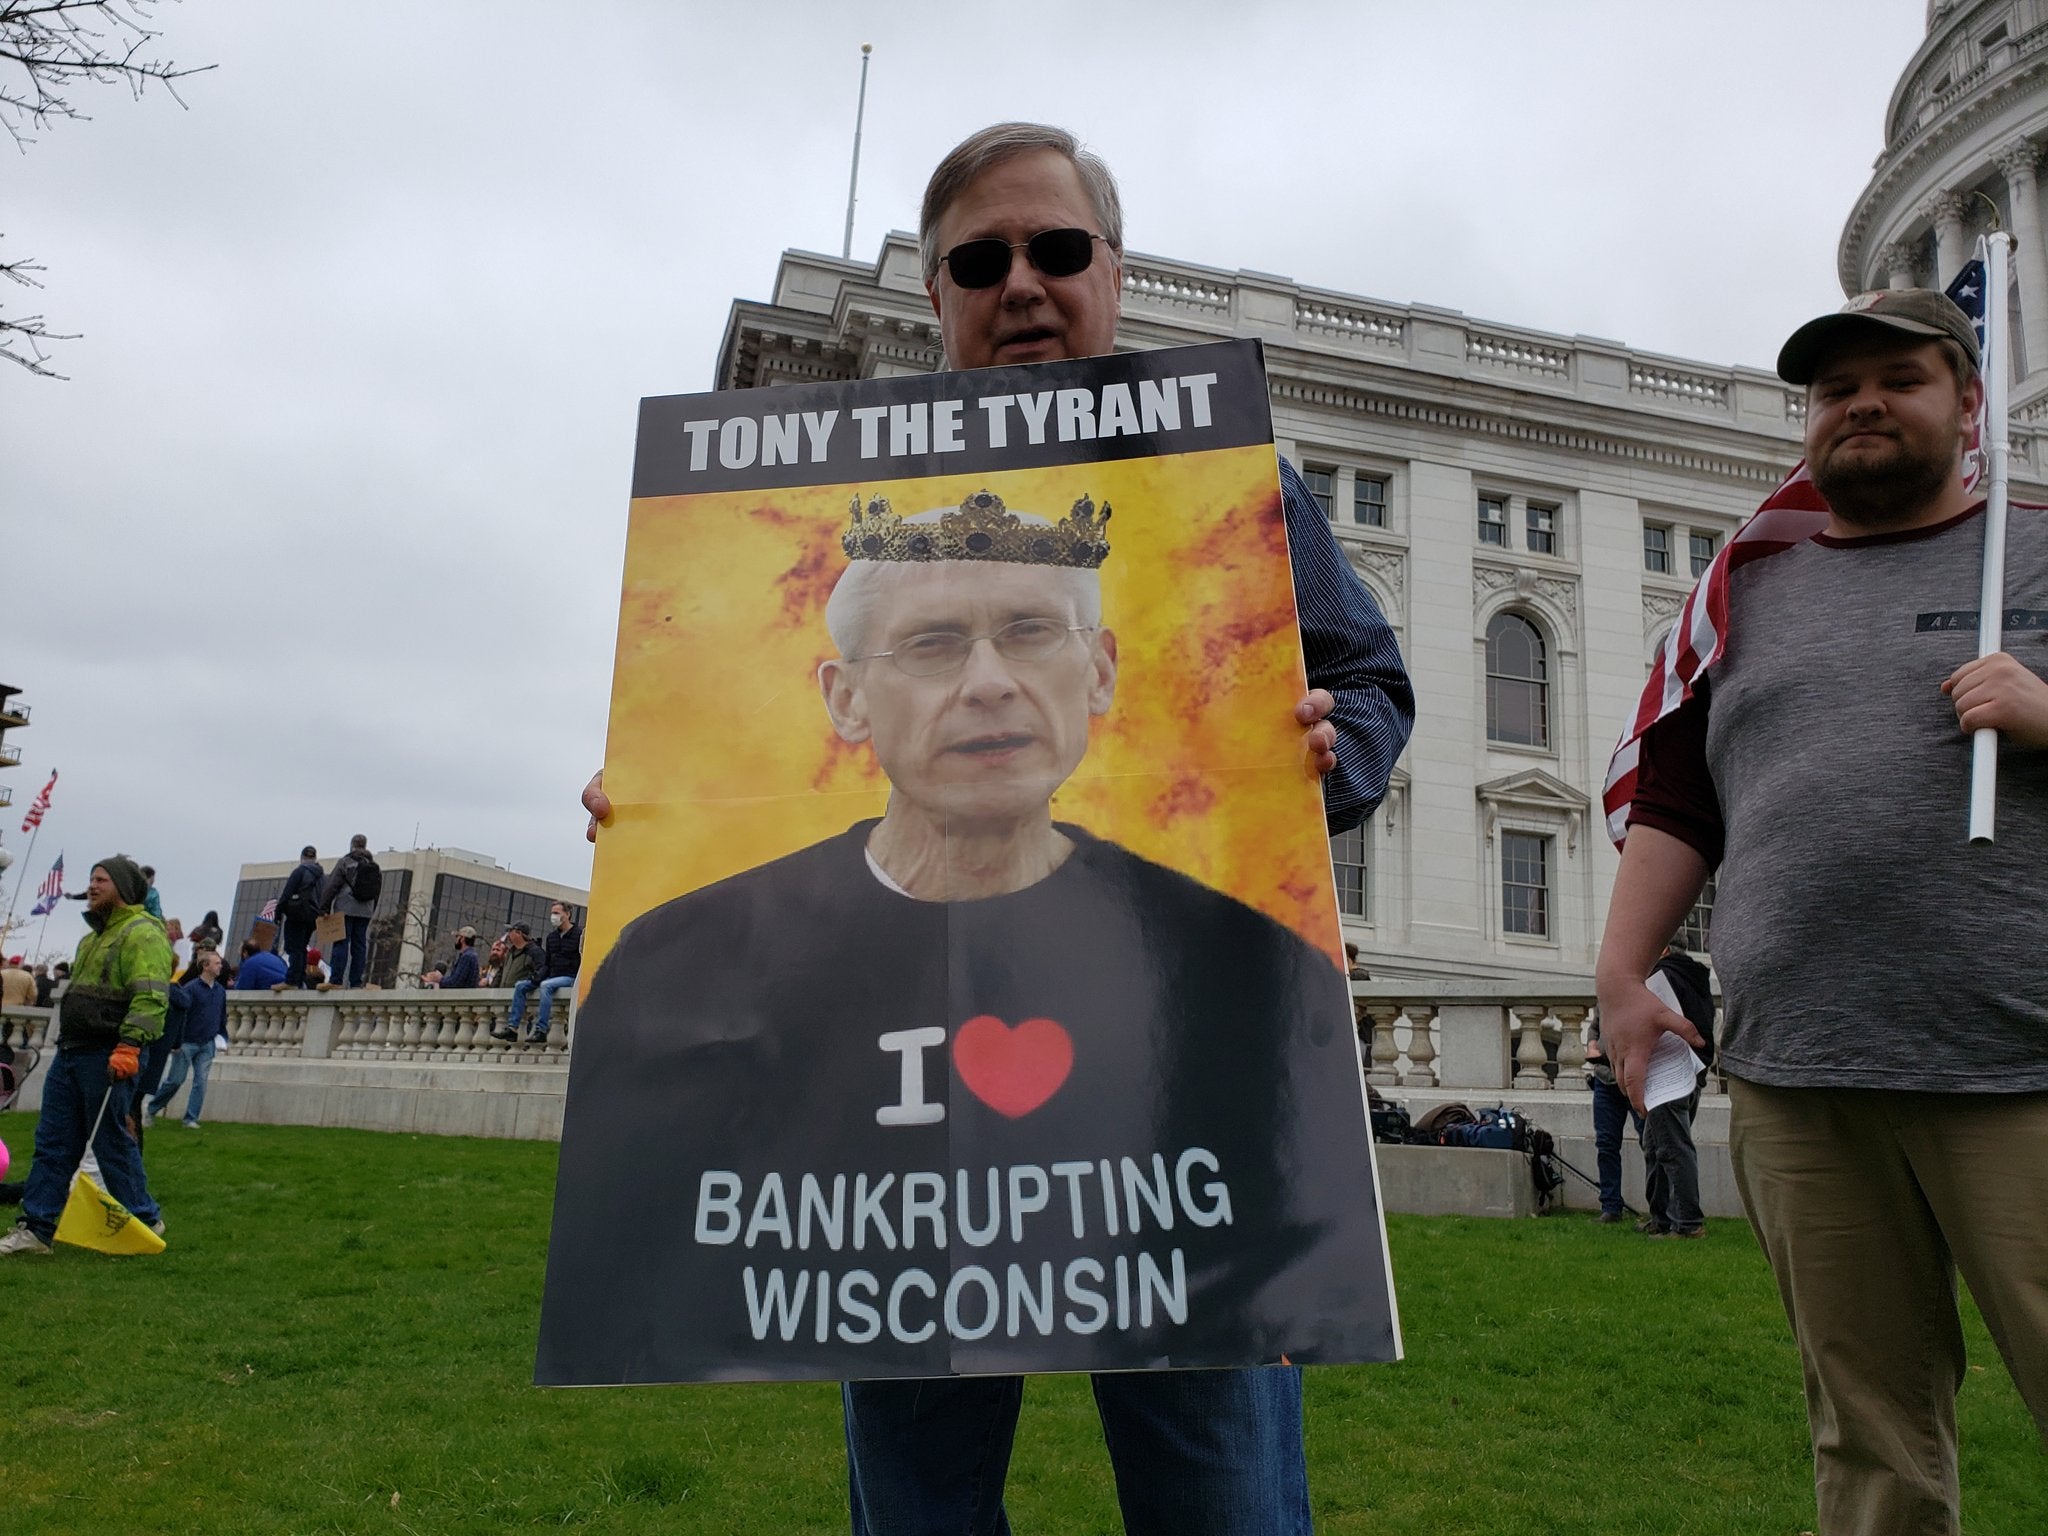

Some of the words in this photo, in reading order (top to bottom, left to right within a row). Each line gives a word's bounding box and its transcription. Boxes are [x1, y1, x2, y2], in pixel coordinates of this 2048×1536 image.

[683, 409, 840, 473] TONY
[851, 399, 967, 460] THE
[978, 371, 1219, 450] TYRANT
[875, 1026, 946, 1126] I
[694, 1147, 1234, 1251] BANKRUPTING
[742, 1247, 1189, 1344] WISCONSIN
